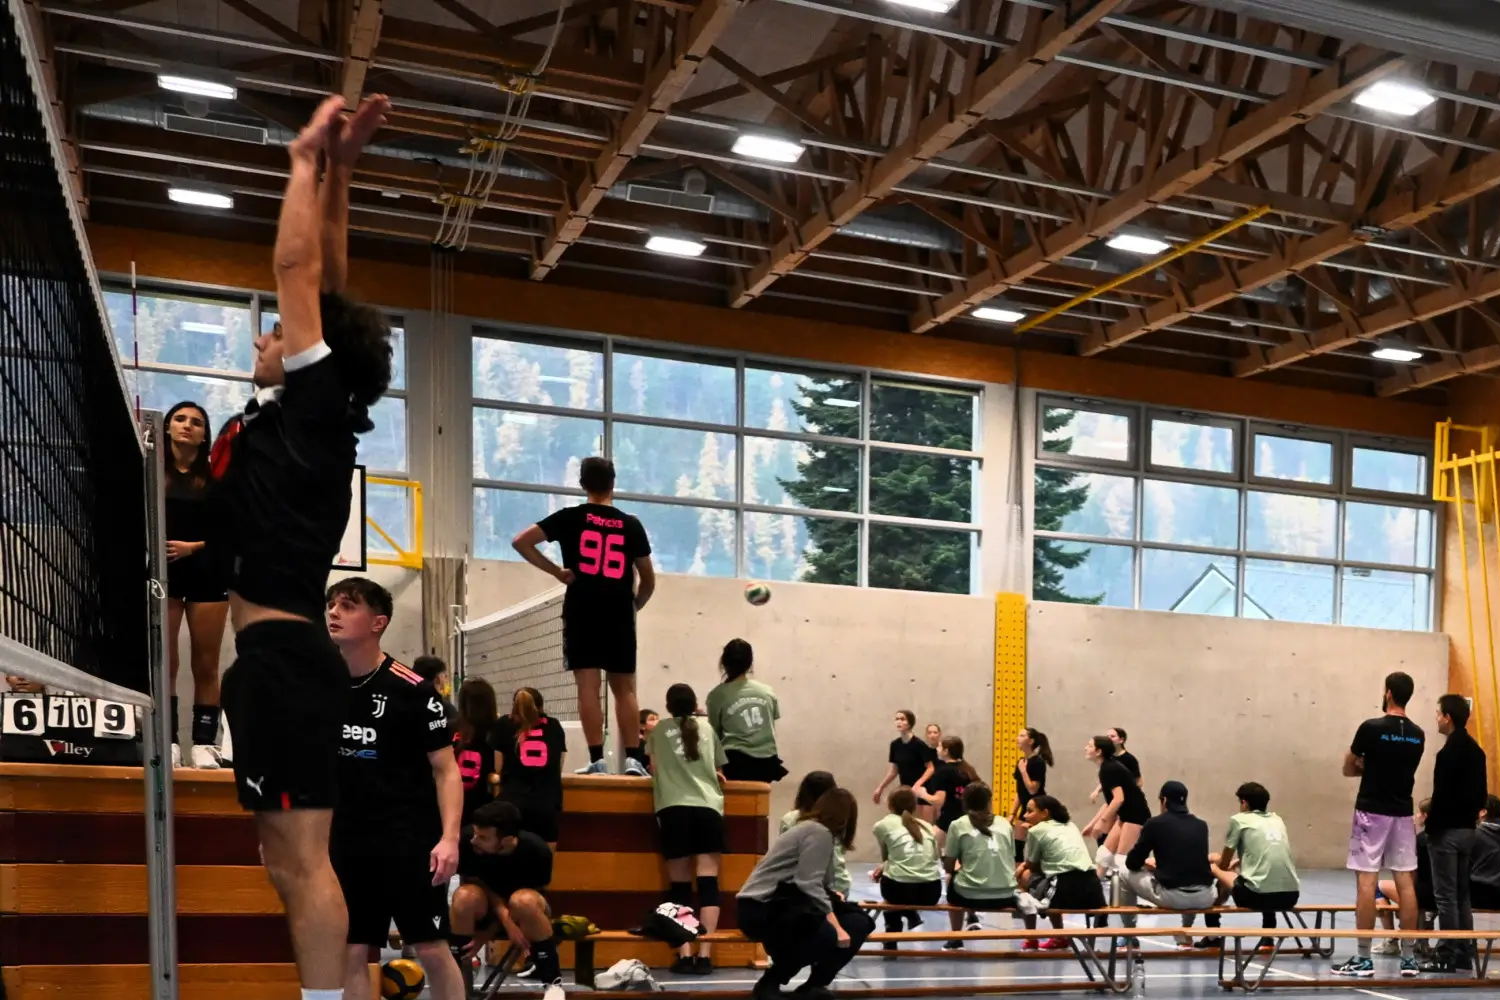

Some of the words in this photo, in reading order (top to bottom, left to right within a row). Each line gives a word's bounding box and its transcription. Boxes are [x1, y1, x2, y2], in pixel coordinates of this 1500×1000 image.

[578, 530, 625, 579] 96
[13, 699, 38, 732] 6
[103, 704, 126, 732] 9
[342, 724, 378, 745] eep
[42, 739, 94, 758] Vlley
